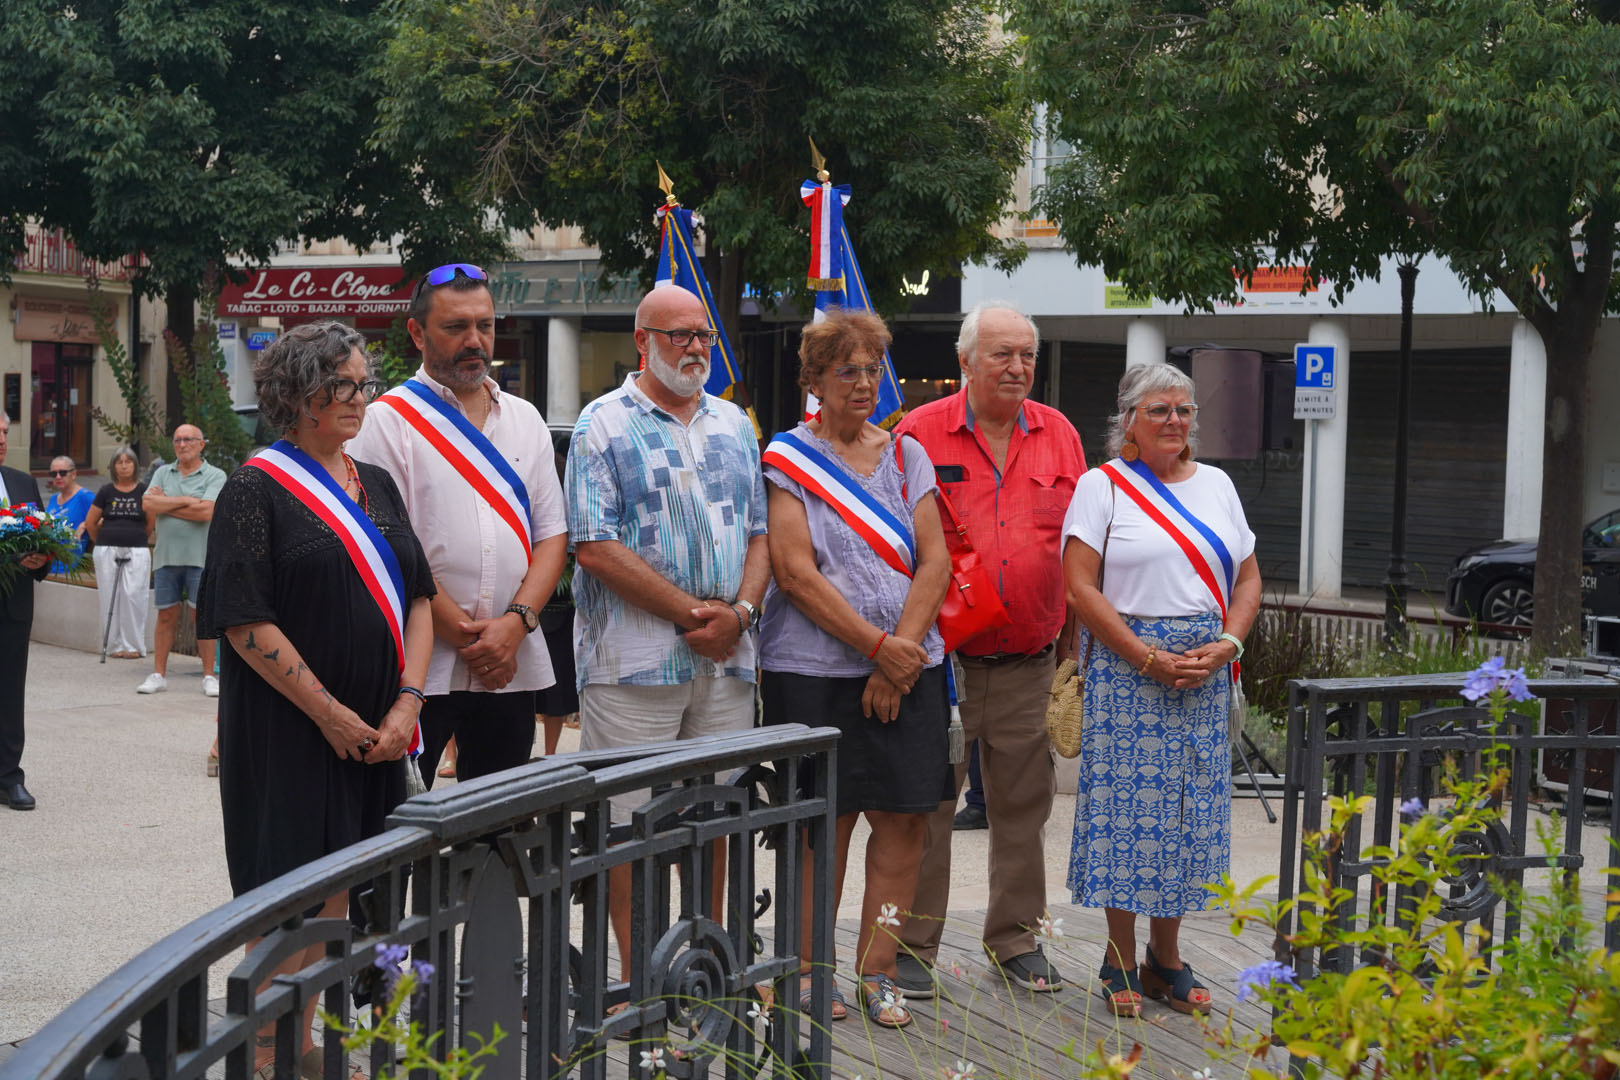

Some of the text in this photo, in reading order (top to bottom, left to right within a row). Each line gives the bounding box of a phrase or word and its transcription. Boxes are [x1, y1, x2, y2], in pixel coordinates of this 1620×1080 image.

[243, 271, 283, 299] Le
[226, 303, 262, 313] TABAC
[270, 303, 299, 313] LOTO
[308, 303, 346, 313] BAZAR
[1305, 353, 1325, 381] P
